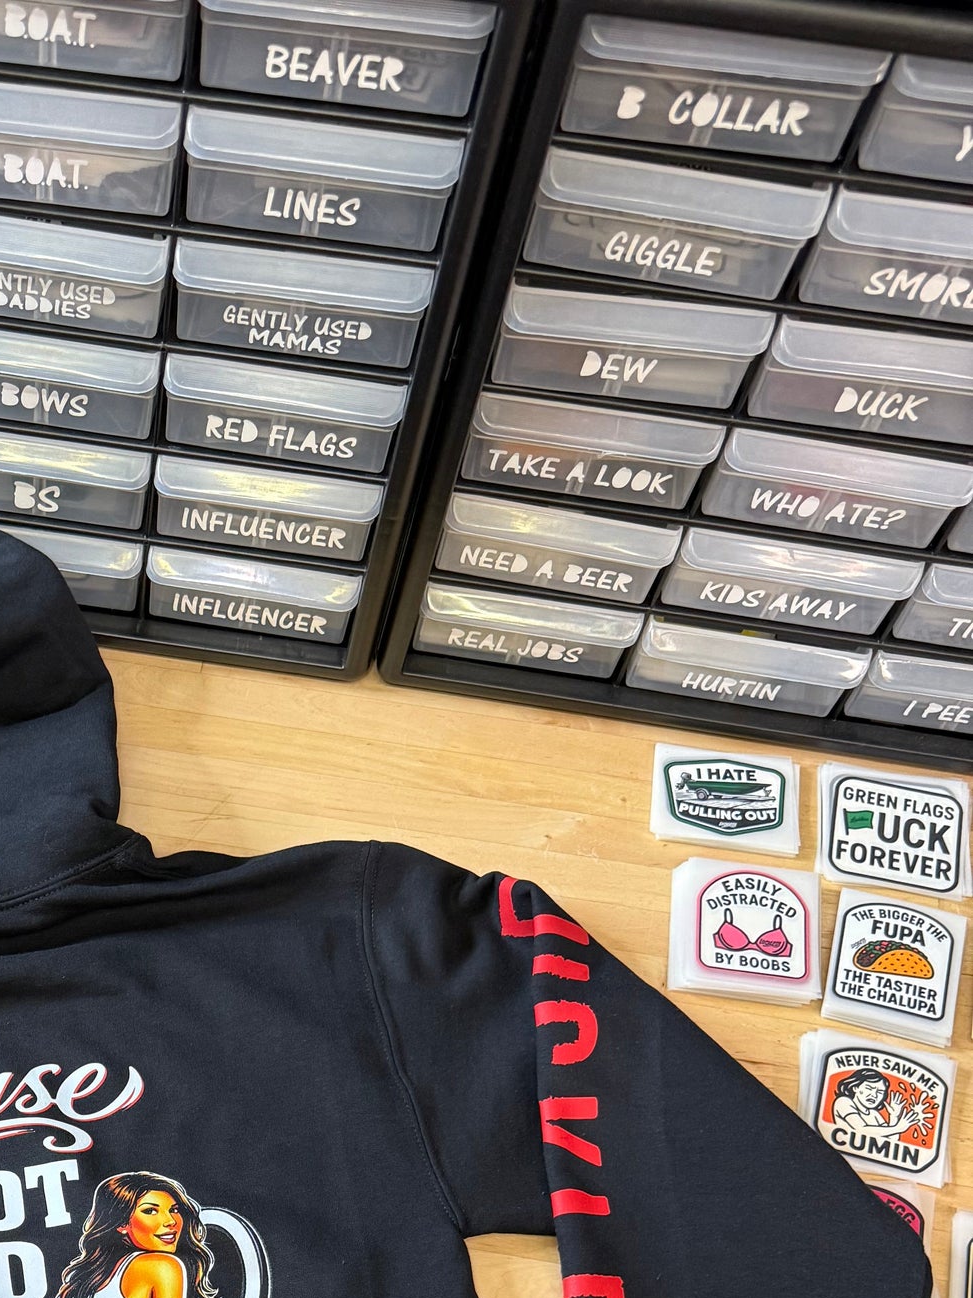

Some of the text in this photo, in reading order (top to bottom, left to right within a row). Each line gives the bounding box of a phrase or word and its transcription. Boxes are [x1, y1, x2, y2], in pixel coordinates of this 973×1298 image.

[3, 6, 96, 49] B.O.A.T.
[264, 44, 405, 91] BEAVER
[617, 85, 810, 136] B COLLAR
[3, 152, 89, 190] B.O.A.T.
[263, 187, 360, 226] LINES
[604, 231, 721, 277] GIGGLE
[60, 281, 116, 305] USED
[223, 305, 373, 341] GENTLY USED
[247, 328, 341, 356] MAMAS
[579, 351, 659, 384] DEW
[0, 381, 89, 418] BOWS
[833, 386, 929, 422] DUCK
[205, 414, 358, 459] RED FLAGS
[488, 449, 674, 495] TAKE A LOOK
[13, 480, 61, 514] BS
[750, 488, 906, 531] WHO ATE?
[181, 507, 347, 550] INFLUENCER
[460, 544, 633, 593] NEED A BEER
[172, 593, 328, 636] INFLUENCER
[700, 581, 857, 622] KIDS AWAY
[448, 628, 584, 664] REAL JOBS
[682, 671, 781, 701] HURTIN
[903, 700, 973, 724] I PEE
[696, 768, 757, 782] I HATE
[678, 803, 776, 822] PULLING OUT
[843, 786, 955, 821] GREEN FLAGS
[877, 814, 951, 855] UCK
[835, 840, 952, 881] FOREVER
[722, 877, 782, 897] EASILY
[706, 894, 797, 919] DISTRACTED
[851, 909, 948, 943] THE BIGGER THE
[870, 919, 926, 947] FUPA
[714, 951, 791, 973] BY BOOBS
[840, 981, 938, 1016] THE CHALUPA
[843, 968, 938, 1002] THE TASTIER
[835, 1054, 939, 1093] NEVER SAW ME
[830, 1127, 920, 1167] CUMIN
